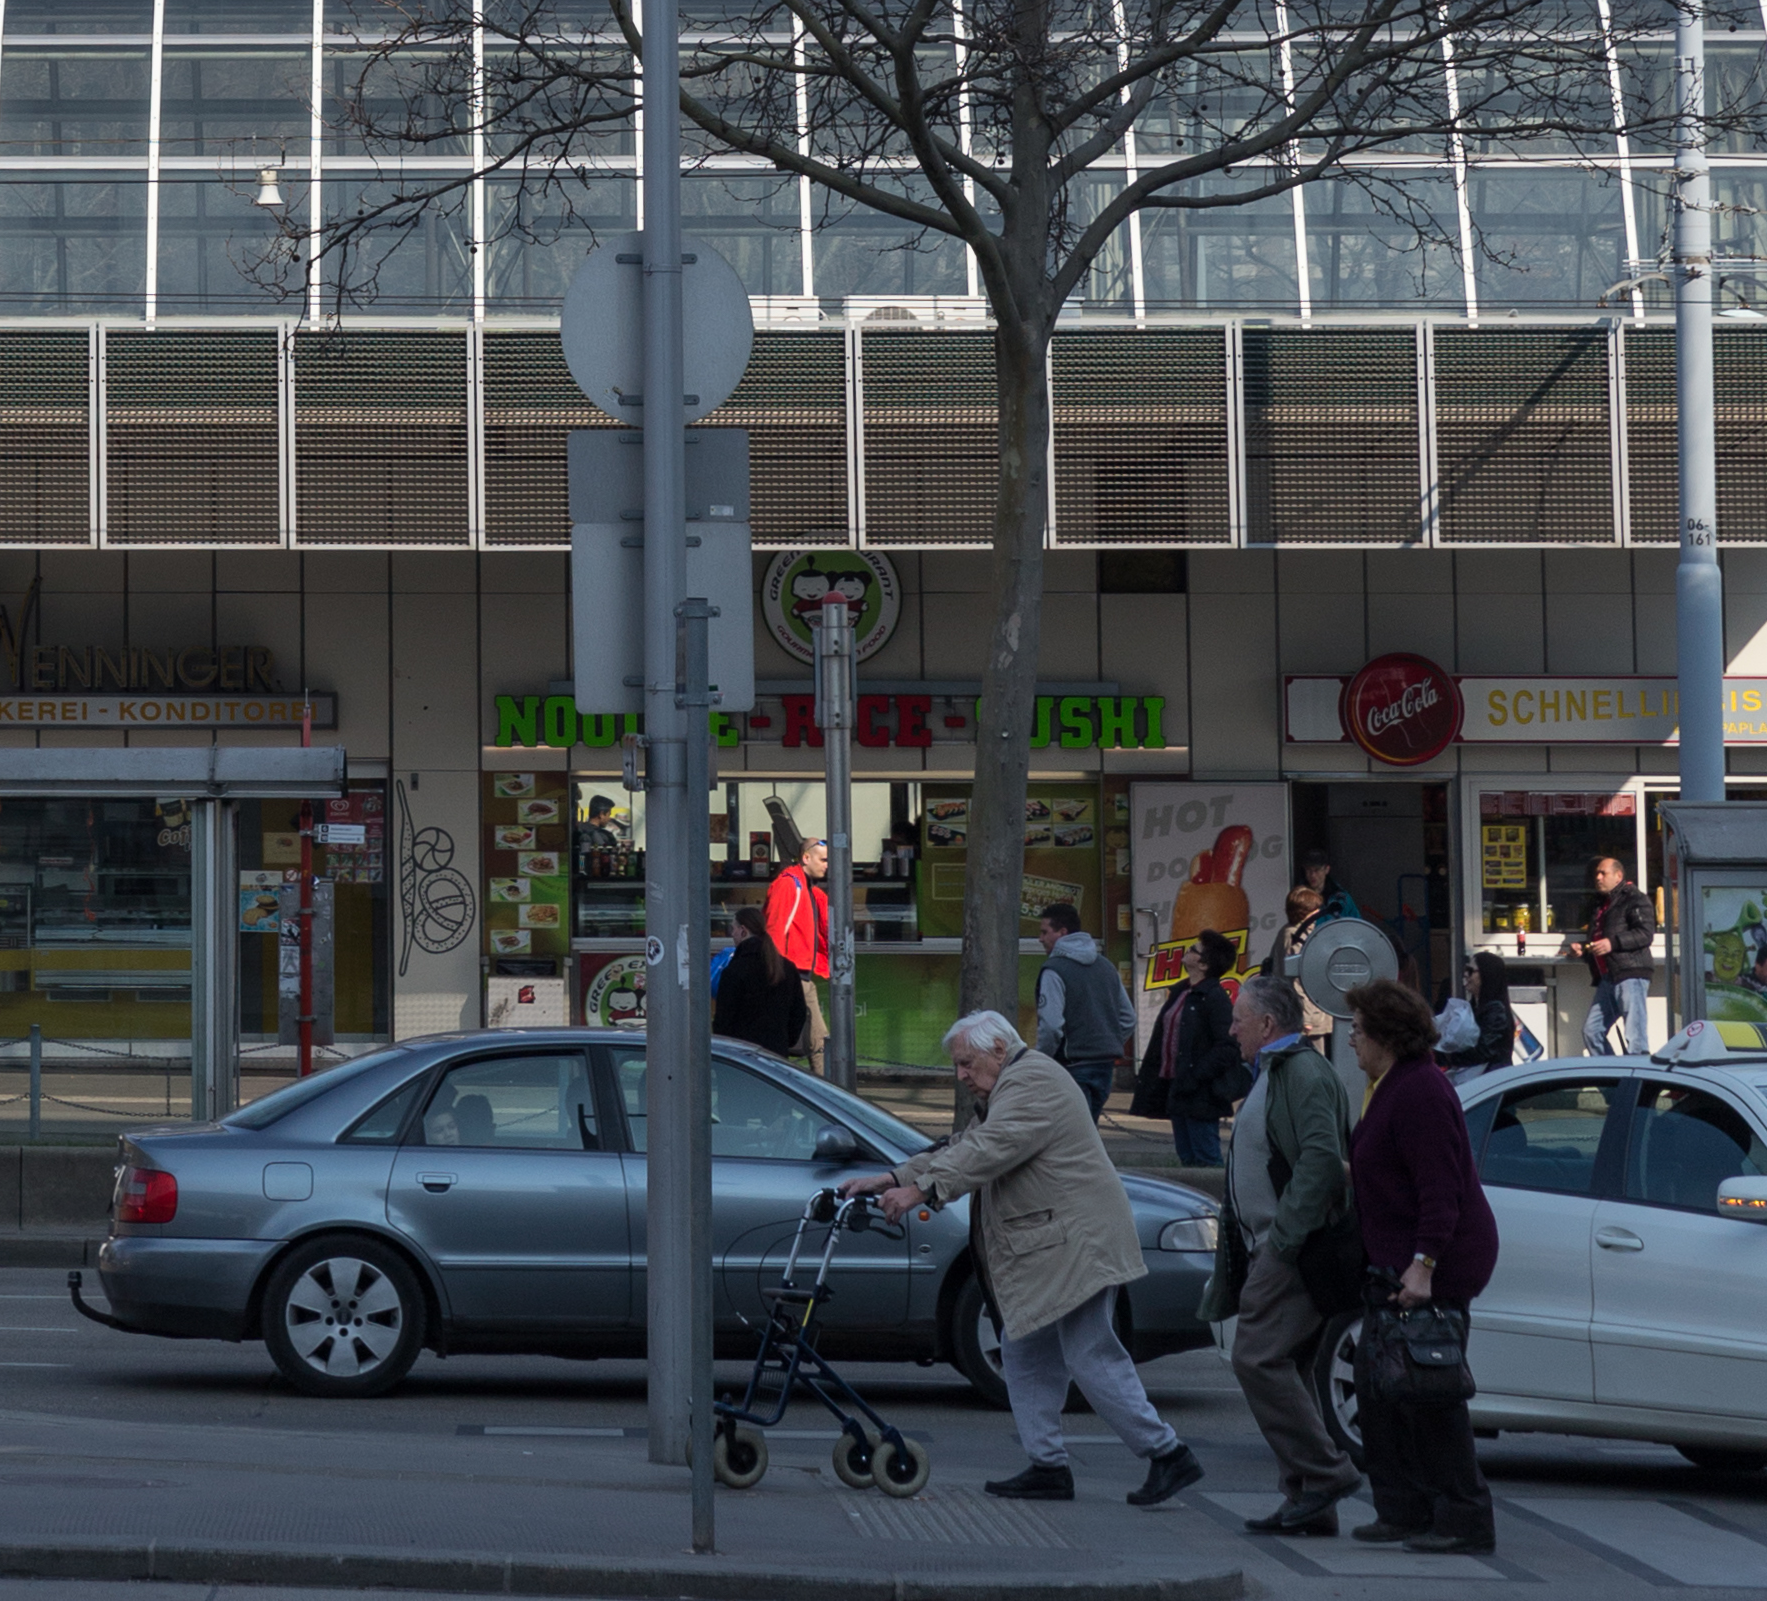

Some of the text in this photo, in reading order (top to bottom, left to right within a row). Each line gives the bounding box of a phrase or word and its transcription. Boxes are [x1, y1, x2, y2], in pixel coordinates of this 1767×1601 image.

[1687, 518, 1710, 531] 06-
[1688, 533, 1710, 546] 161
[119, 701, 318, 721] KONDITOREI
[782, 695, 932, 748] RCE
[1142, 794, 1233, 840] HOT
